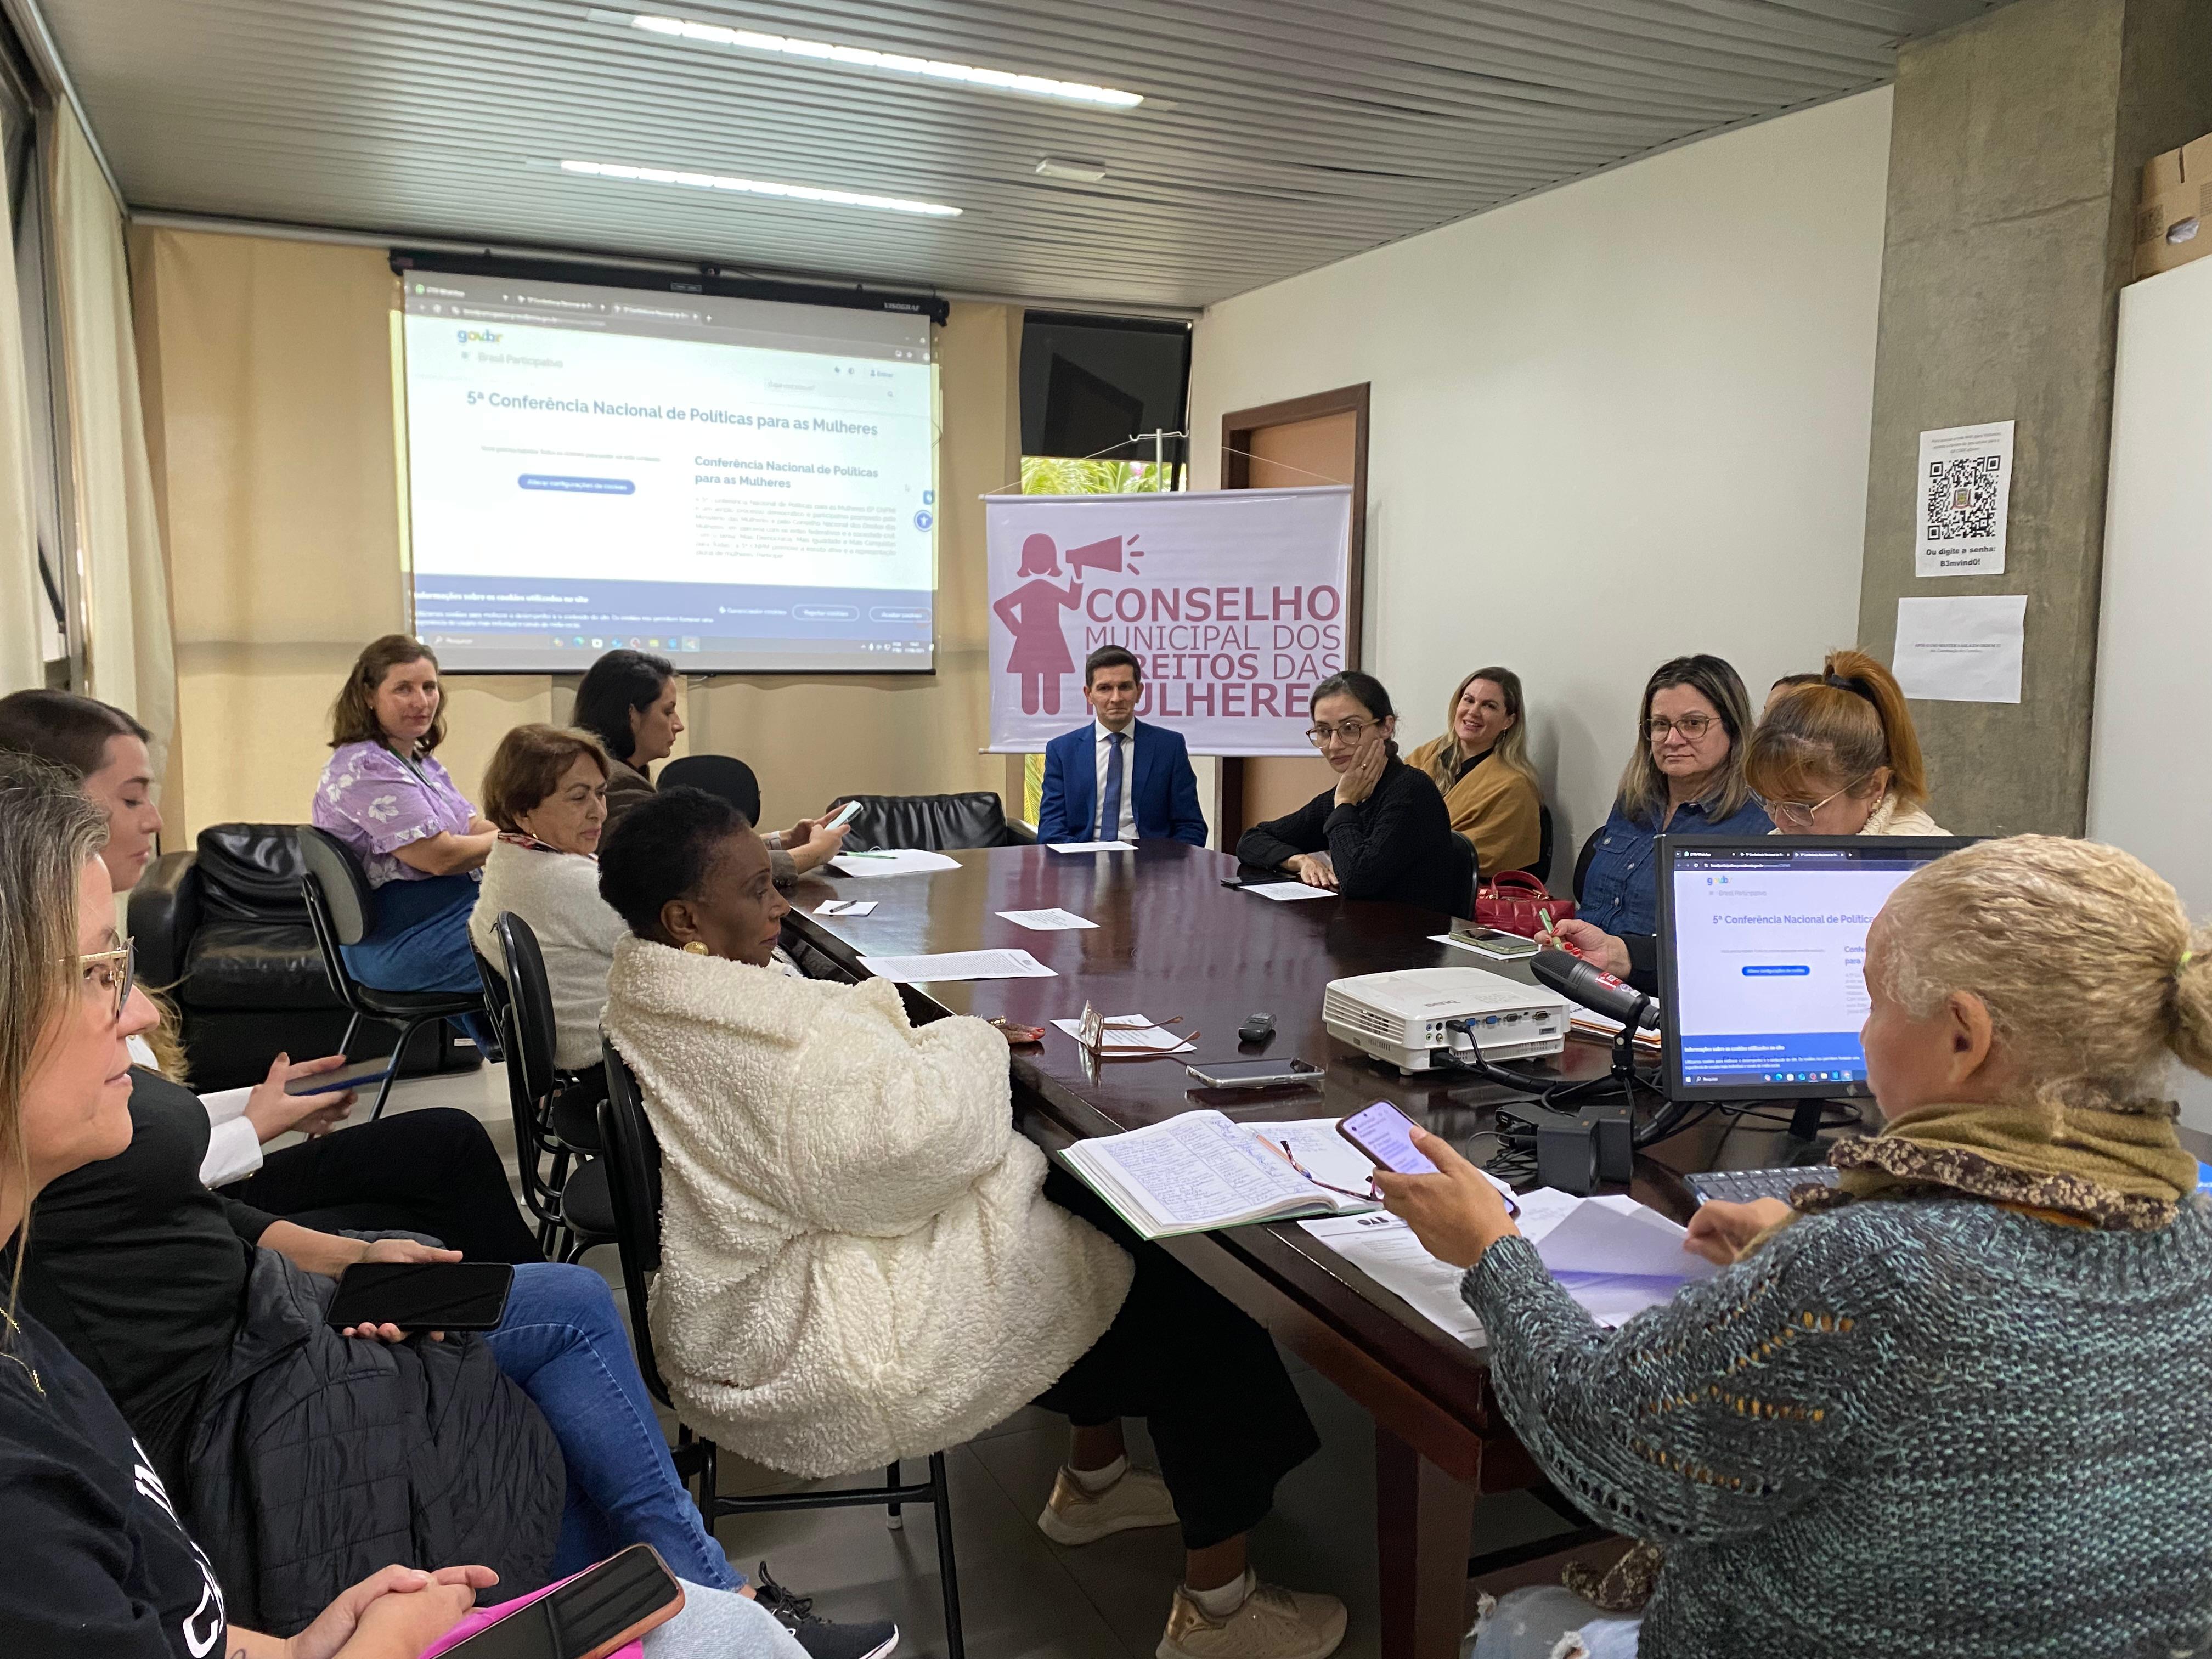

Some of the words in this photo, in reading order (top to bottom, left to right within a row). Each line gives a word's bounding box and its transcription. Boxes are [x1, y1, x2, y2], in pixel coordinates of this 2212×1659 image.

[489, 392, 590, 413] Conferência
[594, 400, 663, 419] Nacional
[666, 407, 686, 420] de
[690, 408, 753, 426] Políticas
[757, 415, 790, 429] para
[793, 420, 809, 431] as
[813, 418, 878, 436] Mulheres
[695, 456, 764, 471] Conferência
[766, 461, 815, 474] Nacional
[817, 464, 831, 475] de
[833, 465, 878, 478] Políticas
[695, 473, 721, 485] para
[724, 476, 736, 485] as
[740, 476, 791, 488] Mulheres
[1938, 548, 1960, 556] digite
[1086, 585, 1340, 623] CONSELHO
[1086, 625, 1260, 651] MUNICIPAL
[1273, 624, 1341, 651] DOS
[1086, 653, 1258, 680] REITOS
[1273, 653, 1341, 680] DAS
[1086, 682, 1312, 718] ULHERE
[1713, 915, 1723, 924] 5ª
[1725, 915, 1782, 924] Conferência
[1784, 914, 1825, 924] Nacional
[1827, 914, 1838, 923] de
[1841, 914, 1874, 923] Política
